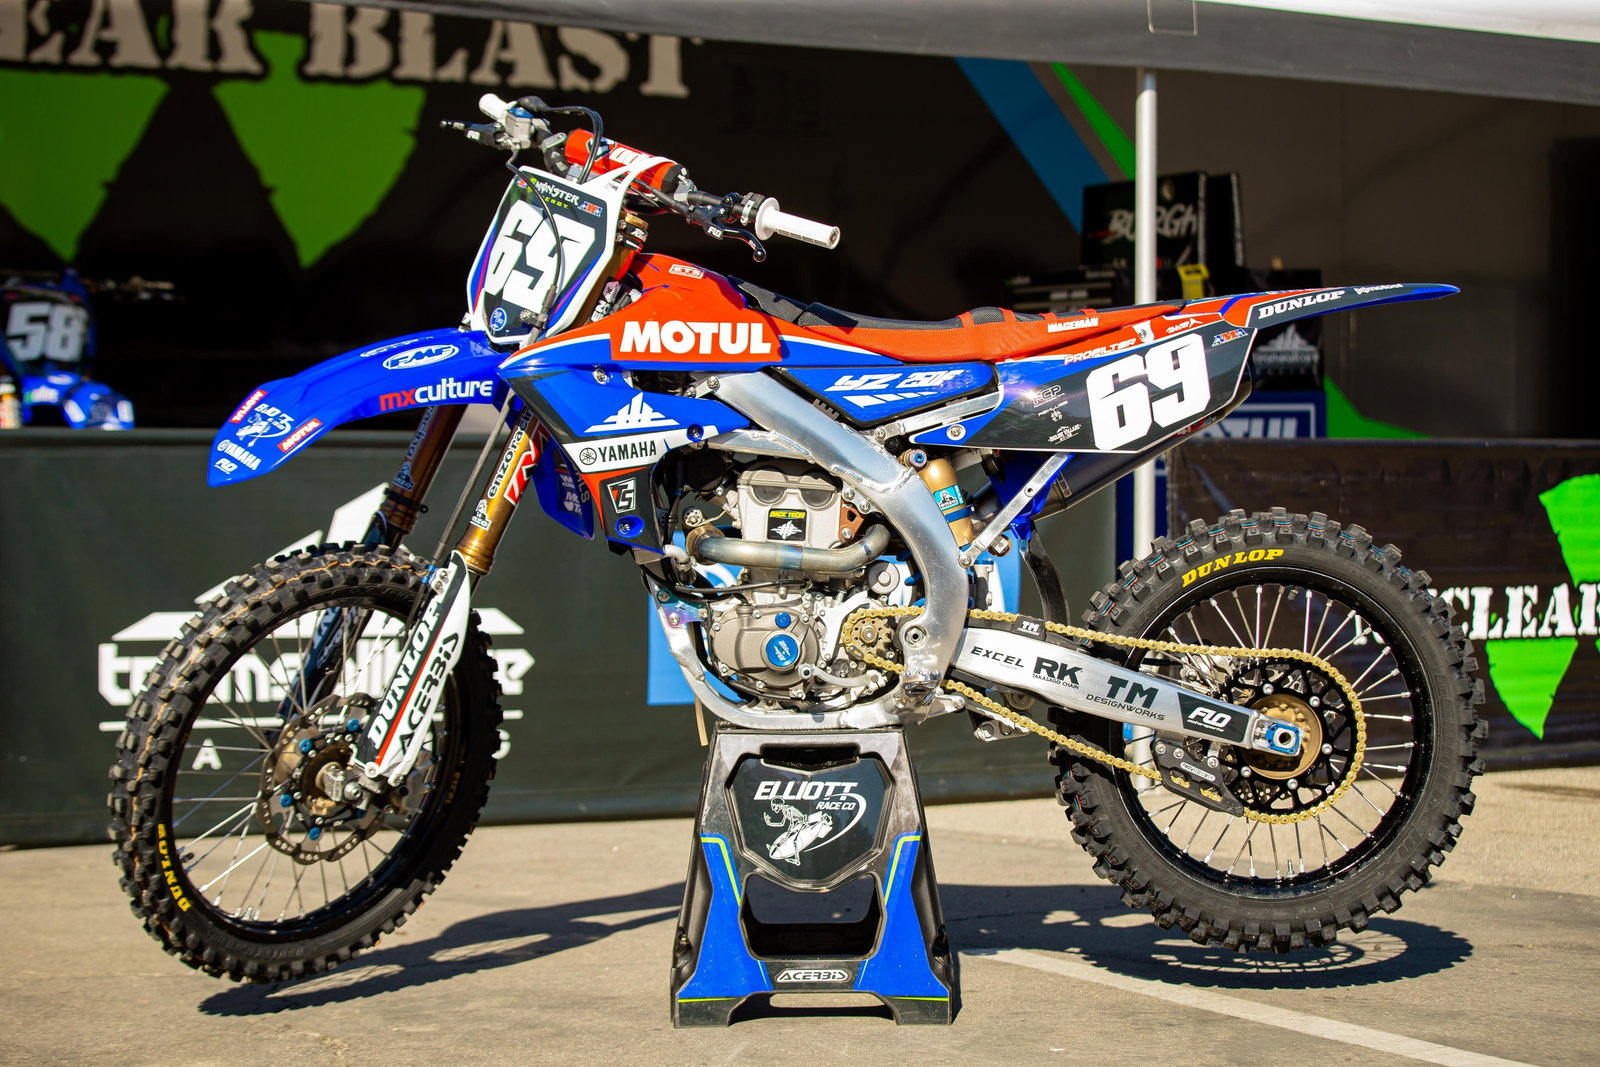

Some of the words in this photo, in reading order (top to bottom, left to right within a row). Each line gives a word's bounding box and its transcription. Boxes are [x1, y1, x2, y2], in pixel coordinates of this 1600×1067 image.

[306, 2, 702, 97] BLAST
[535, 181, 580, 206] MONSTER
[483, 200, 595, 314] 69
[1258, 291, 1345, 319] DUNLOP
[6, 302, 88, 362] 58
[620, 320, 773, 354] MOTUL
[1211, 328, 1248, 347] AMA
[1064, 338, 1137, 366] PROFILTER
[1086, 333, 1211, 451] 69
[282, 420, 320, 451] MOTUL
[224, 442, 262, 470] YAMAHA
[598, 440, 657, 462] YAMAHA
[1182, 549, 1284, 587] DUNLOP
[1022, 621, 1040, 632] TM
[971, 646, 1024, 667] EXCEL
[1033, 656, 1083, 685] RK
[367, 598, 441, 750] DUNLOP
[1062, 681, 1079, 689] CHAIN
[399, 633, 459, 756] ACERBIS
[1085, 693, 1166, 720] DESIGNWORKS
[1107, 676, 1159, 709] TM
[1188, 706, 1232, 728] FLO
[753, 780, 858, 801] ELLIOTT
[815, 801, 841, 810] RACE
[841, 801, 855, 810] CO
[777, 970, 849, 983] ACERBIS
